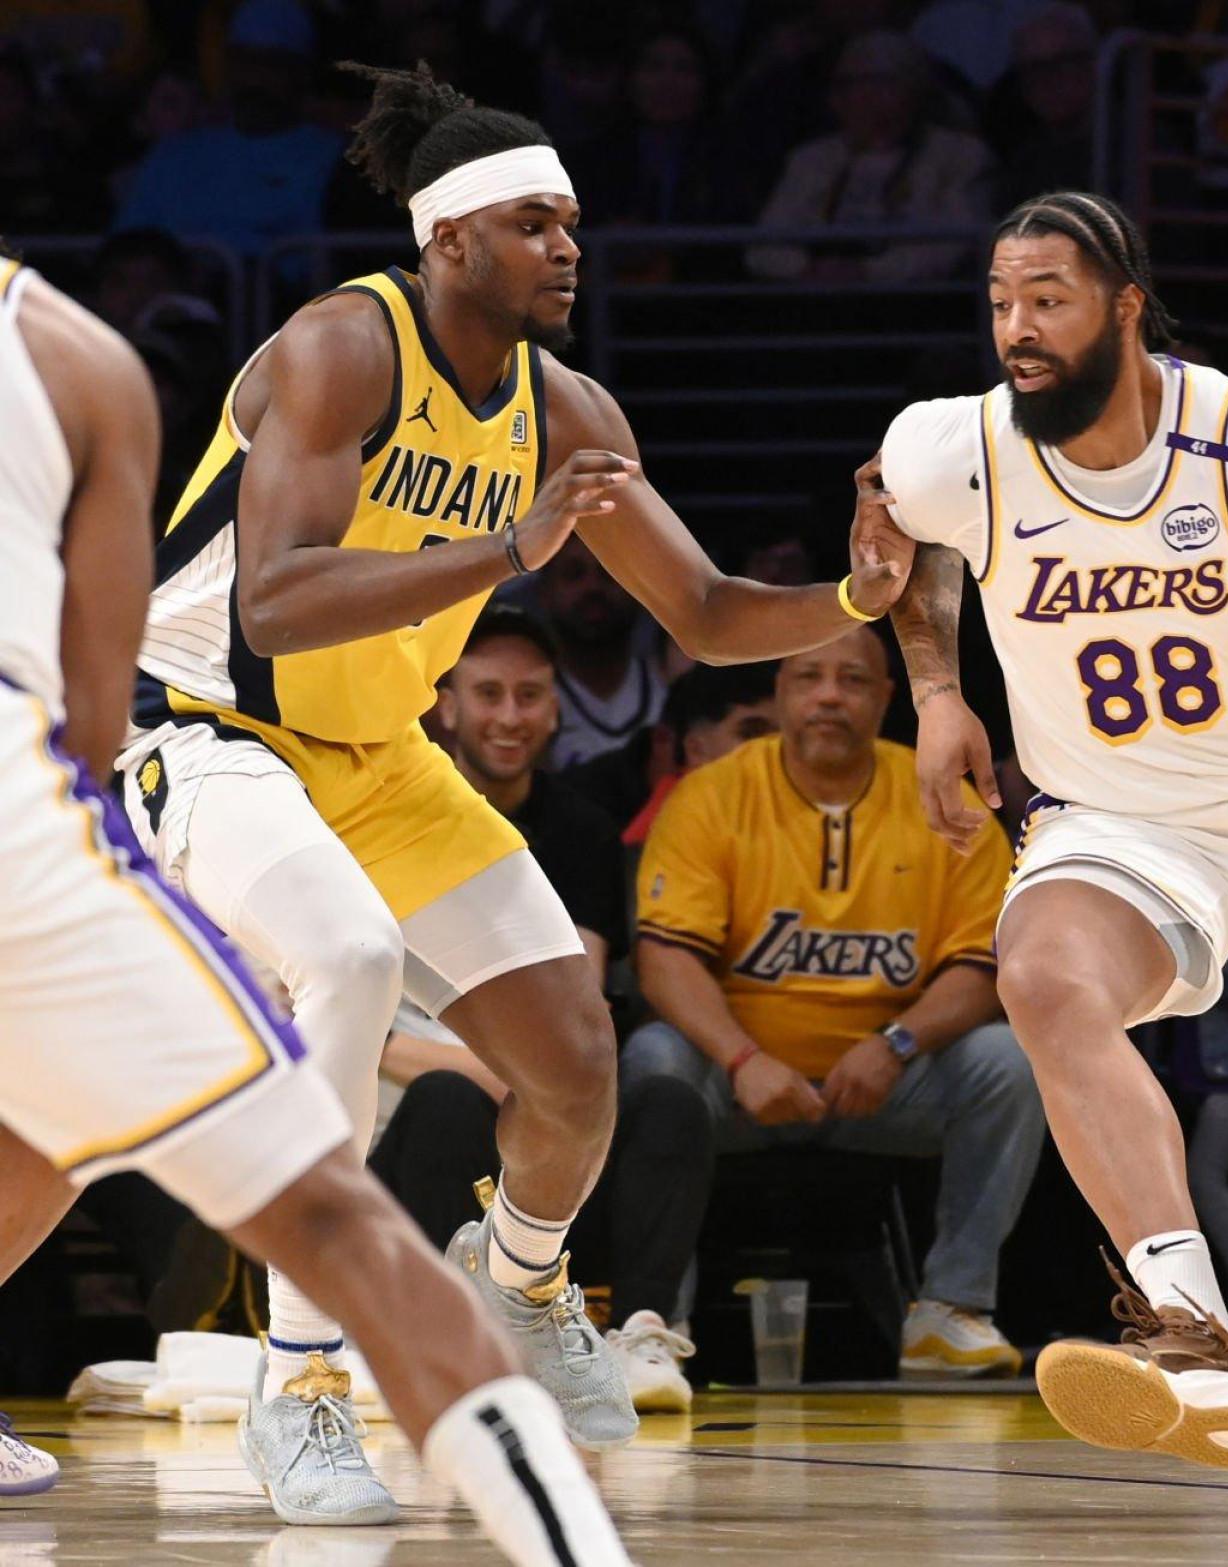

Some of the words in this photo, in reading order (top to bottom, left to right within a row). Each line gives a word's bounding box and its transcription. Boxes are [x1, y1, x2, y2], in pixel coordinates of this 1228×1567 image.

[1190, 440, 1208, 455] 44
[1165, 516, 1216, 536] bibigo
[1076, 634, 1226, 747] 88
[734, 910, 918, 988] LAKERS
